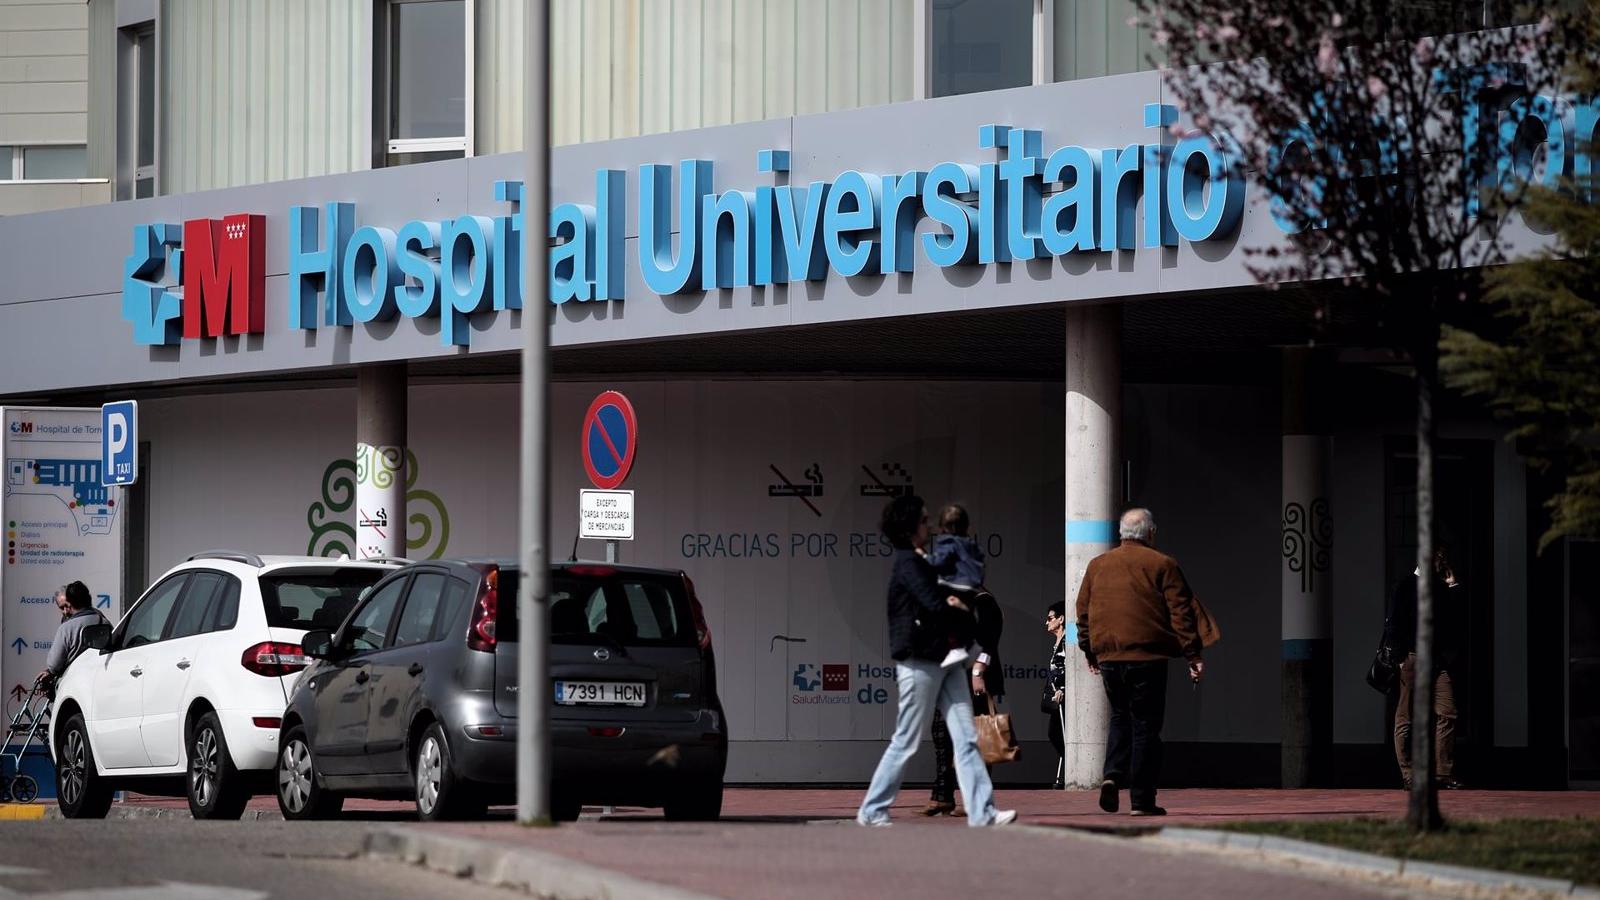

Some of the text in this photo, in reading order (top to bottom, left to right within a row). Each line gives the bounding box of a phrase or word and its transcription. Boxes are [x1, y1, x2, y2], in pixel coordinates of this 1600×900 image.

[184, 213, 266, 339] M
[639, 102, 1244, 297] Universitario
[37, 425, 70, 435] Hospital
[72, 426, 83, 434] de
[108, 413, 127, 475] P
[117, 463, 131, 474] TAXI
[596, 499, 617, 507] EXCEPTO
[584, 510, 599, 518] CARGA
[605, 511, 629, 519] DESCARGA
[589, 522, 594, 530] DE
[681, 533, 780, 558] GRACIAS
[791, 533, 839, 558] POR
[20, 596, 50, 604] Acceso
[568, 684, 642, 700] 7391 HCN
[857, 684, 888, 704] de
